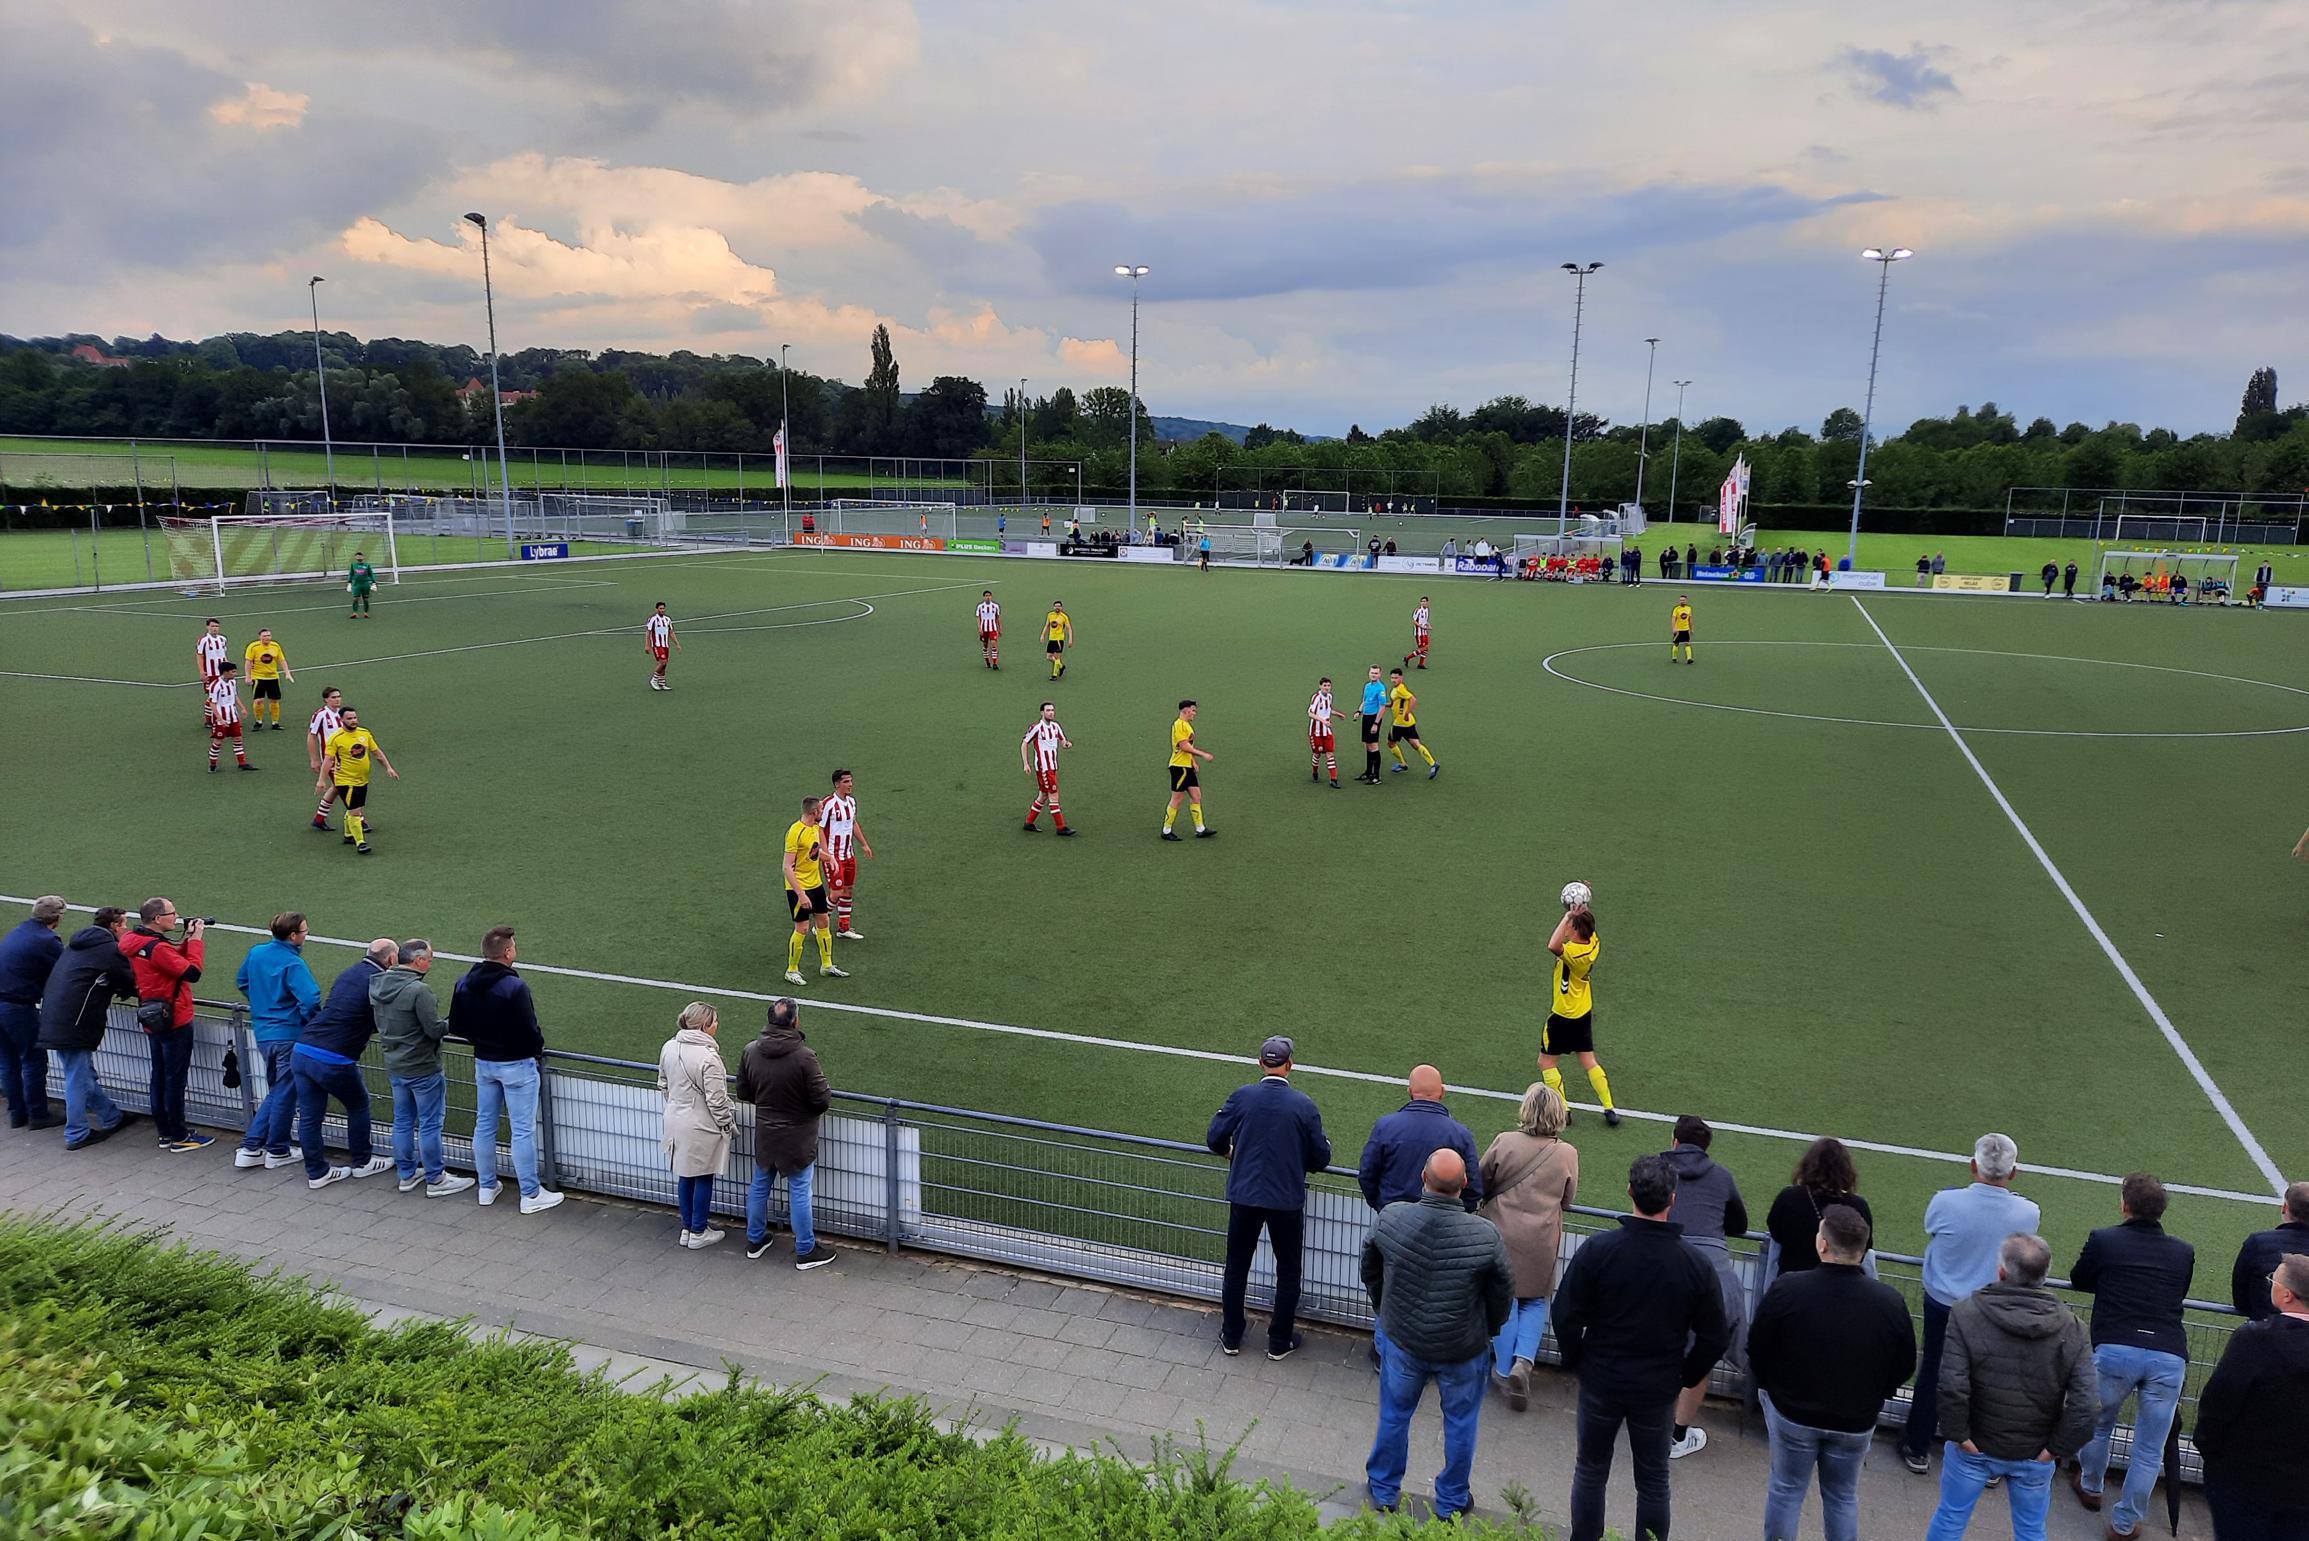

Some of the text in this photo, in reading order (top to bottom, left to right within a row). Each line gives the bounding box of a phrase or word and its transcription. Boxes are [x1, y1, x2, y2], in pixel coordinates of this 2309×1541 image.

[801, 535, 821, 545] ING
[850, 537, 870, 547] ING
[900, 540, 920, 549] ING
[530, 546, 558, 560] Lybrae
[1457, 559, 1505, 572] Raboban
